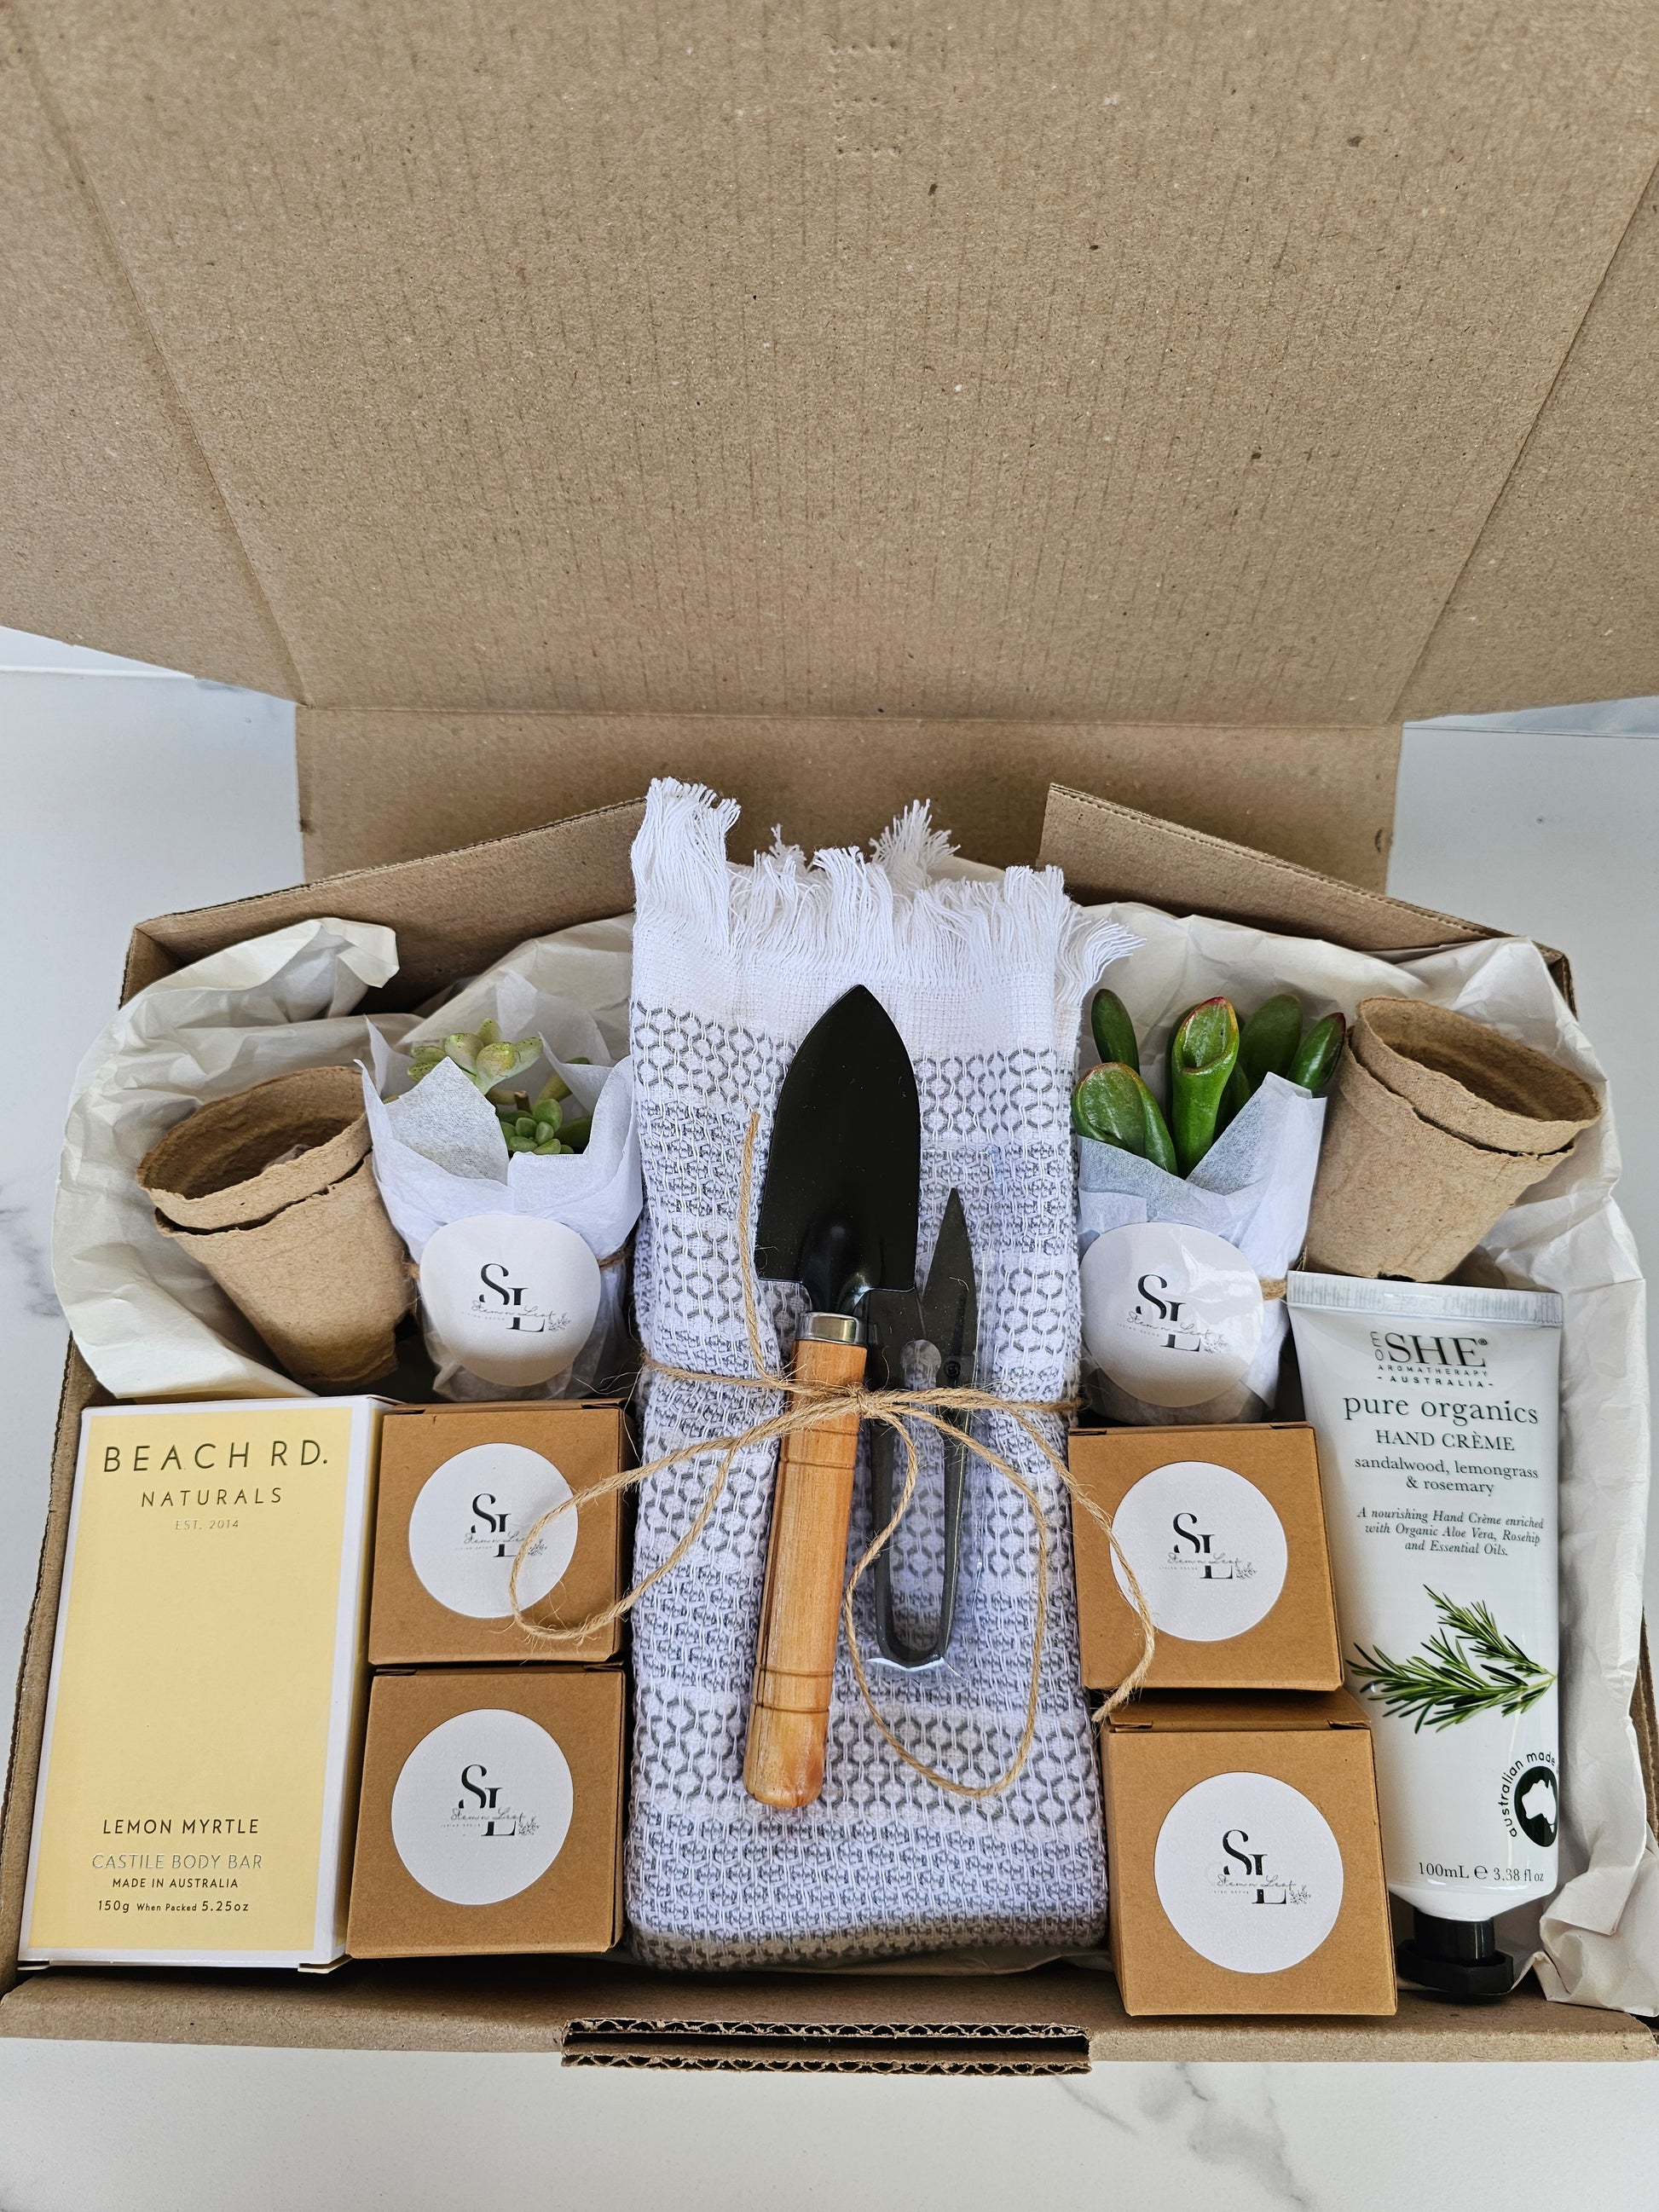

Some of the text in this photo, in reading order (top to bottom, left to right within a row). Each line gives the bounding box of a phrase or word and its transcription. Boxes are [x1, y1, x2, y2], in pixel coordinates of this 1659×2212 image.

[1378, 1364, 1488, 1377] AROMATHERAPY
[1342, 1395, 1539, 1427] pure organics
[1375, 1429, 1515, 1451] HAND CRÈME
[103, 1439, 328, 1472] BEACH RD.
[1355, 1456, 1539, 1480] sandalwood, lemongrass
[1406, 1476, 1494, 1497] & rosemary
[141, 1487, 282, 1507] NATURALS
[175, 1518, 240, 1530] EST. 2014
[1357, 1507, 1544, 1529] A nourishing Hand Crème enriched
[1365, 1522, 1541, 1547] with Organic Aloe Vera, Rosehip
[1405, 1540, 1508, 1556] and Essential Oils.
[1498, 1752, 1556, 1838] australian made
[103, 1818, 259, 1834] LEMON MYRTLE
[92, 1853, 263, 1869] CASTILE BODY BAR
[1419, 1862, 1470, 1879] 100mL
[1493, 1868, 1520, 1881] 3.38
[1534, 1872, 1544, 1882] oz
[112, 1878, 239, 1888] MADE IN AUSTRALIA
[98, 1900, 249, 1914] 150g When Packed 5.25oz
